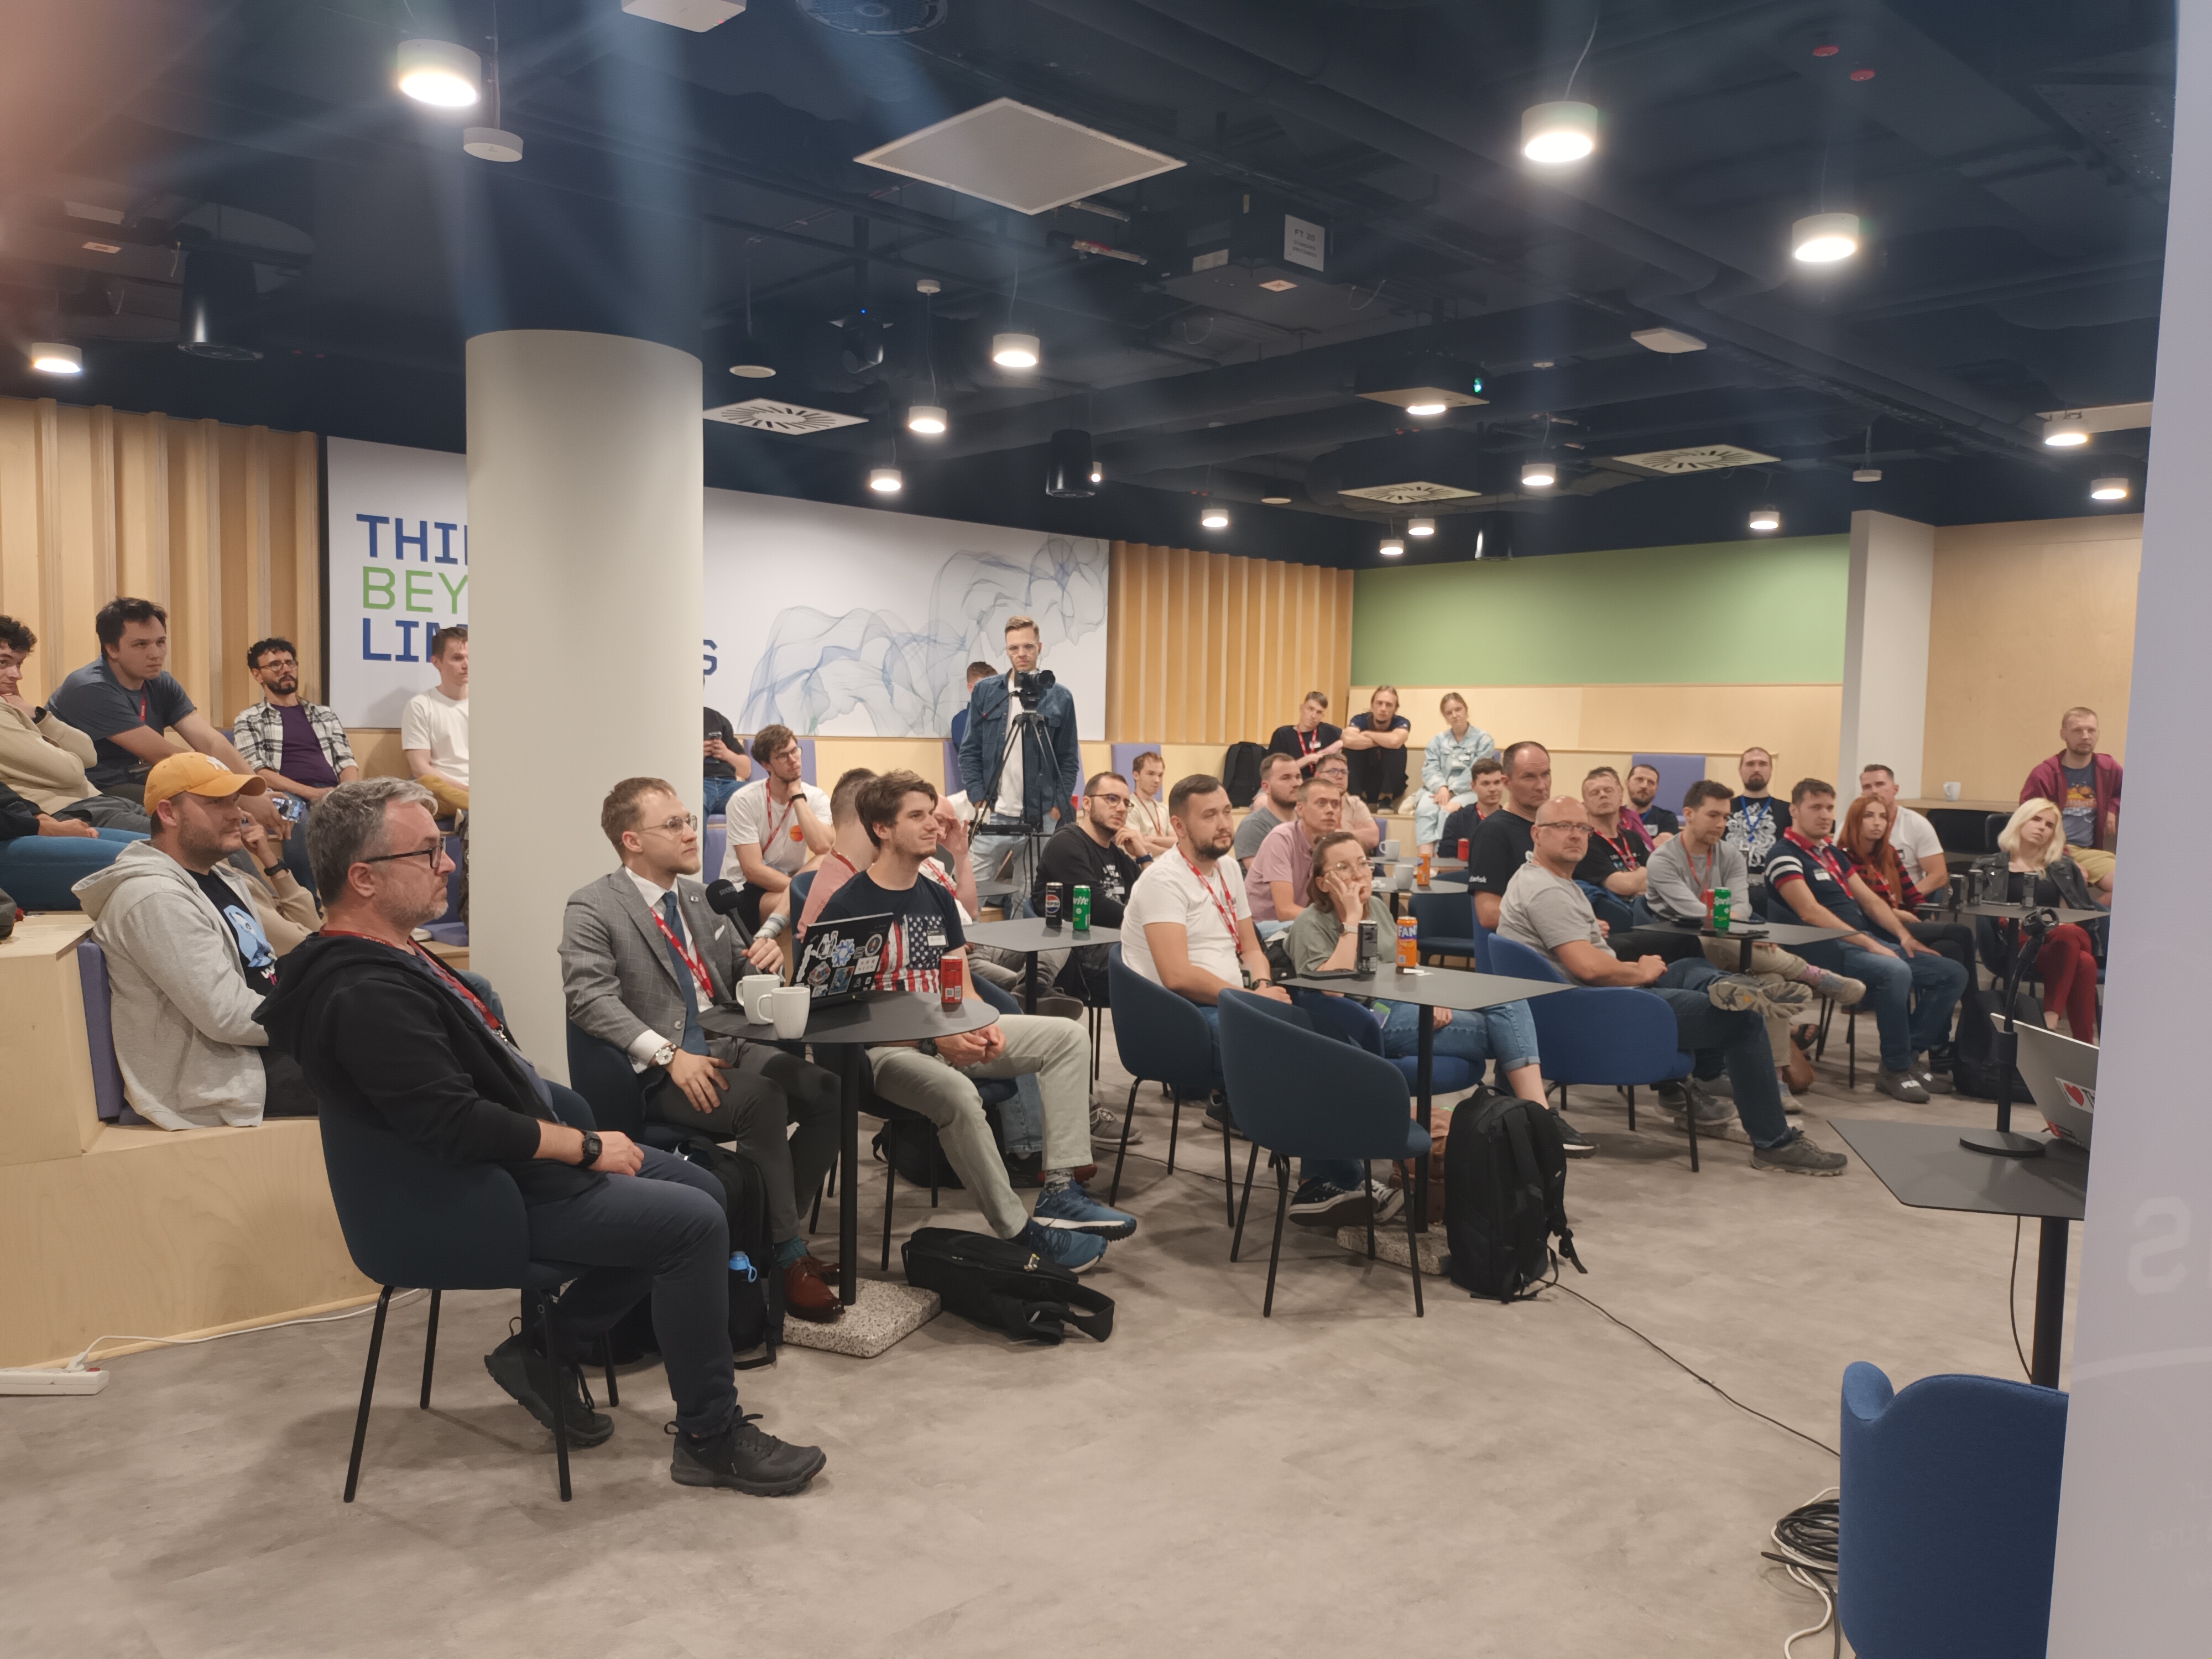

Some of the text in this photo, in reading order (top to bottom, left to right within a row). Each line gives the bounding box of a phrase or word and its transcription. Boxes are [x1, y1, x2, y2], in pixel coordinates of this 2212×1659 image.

[356, 514, 468, 565] THI
[363, 566, 468, 614] BEY
[1398, 925, 1417, 937] FAN
